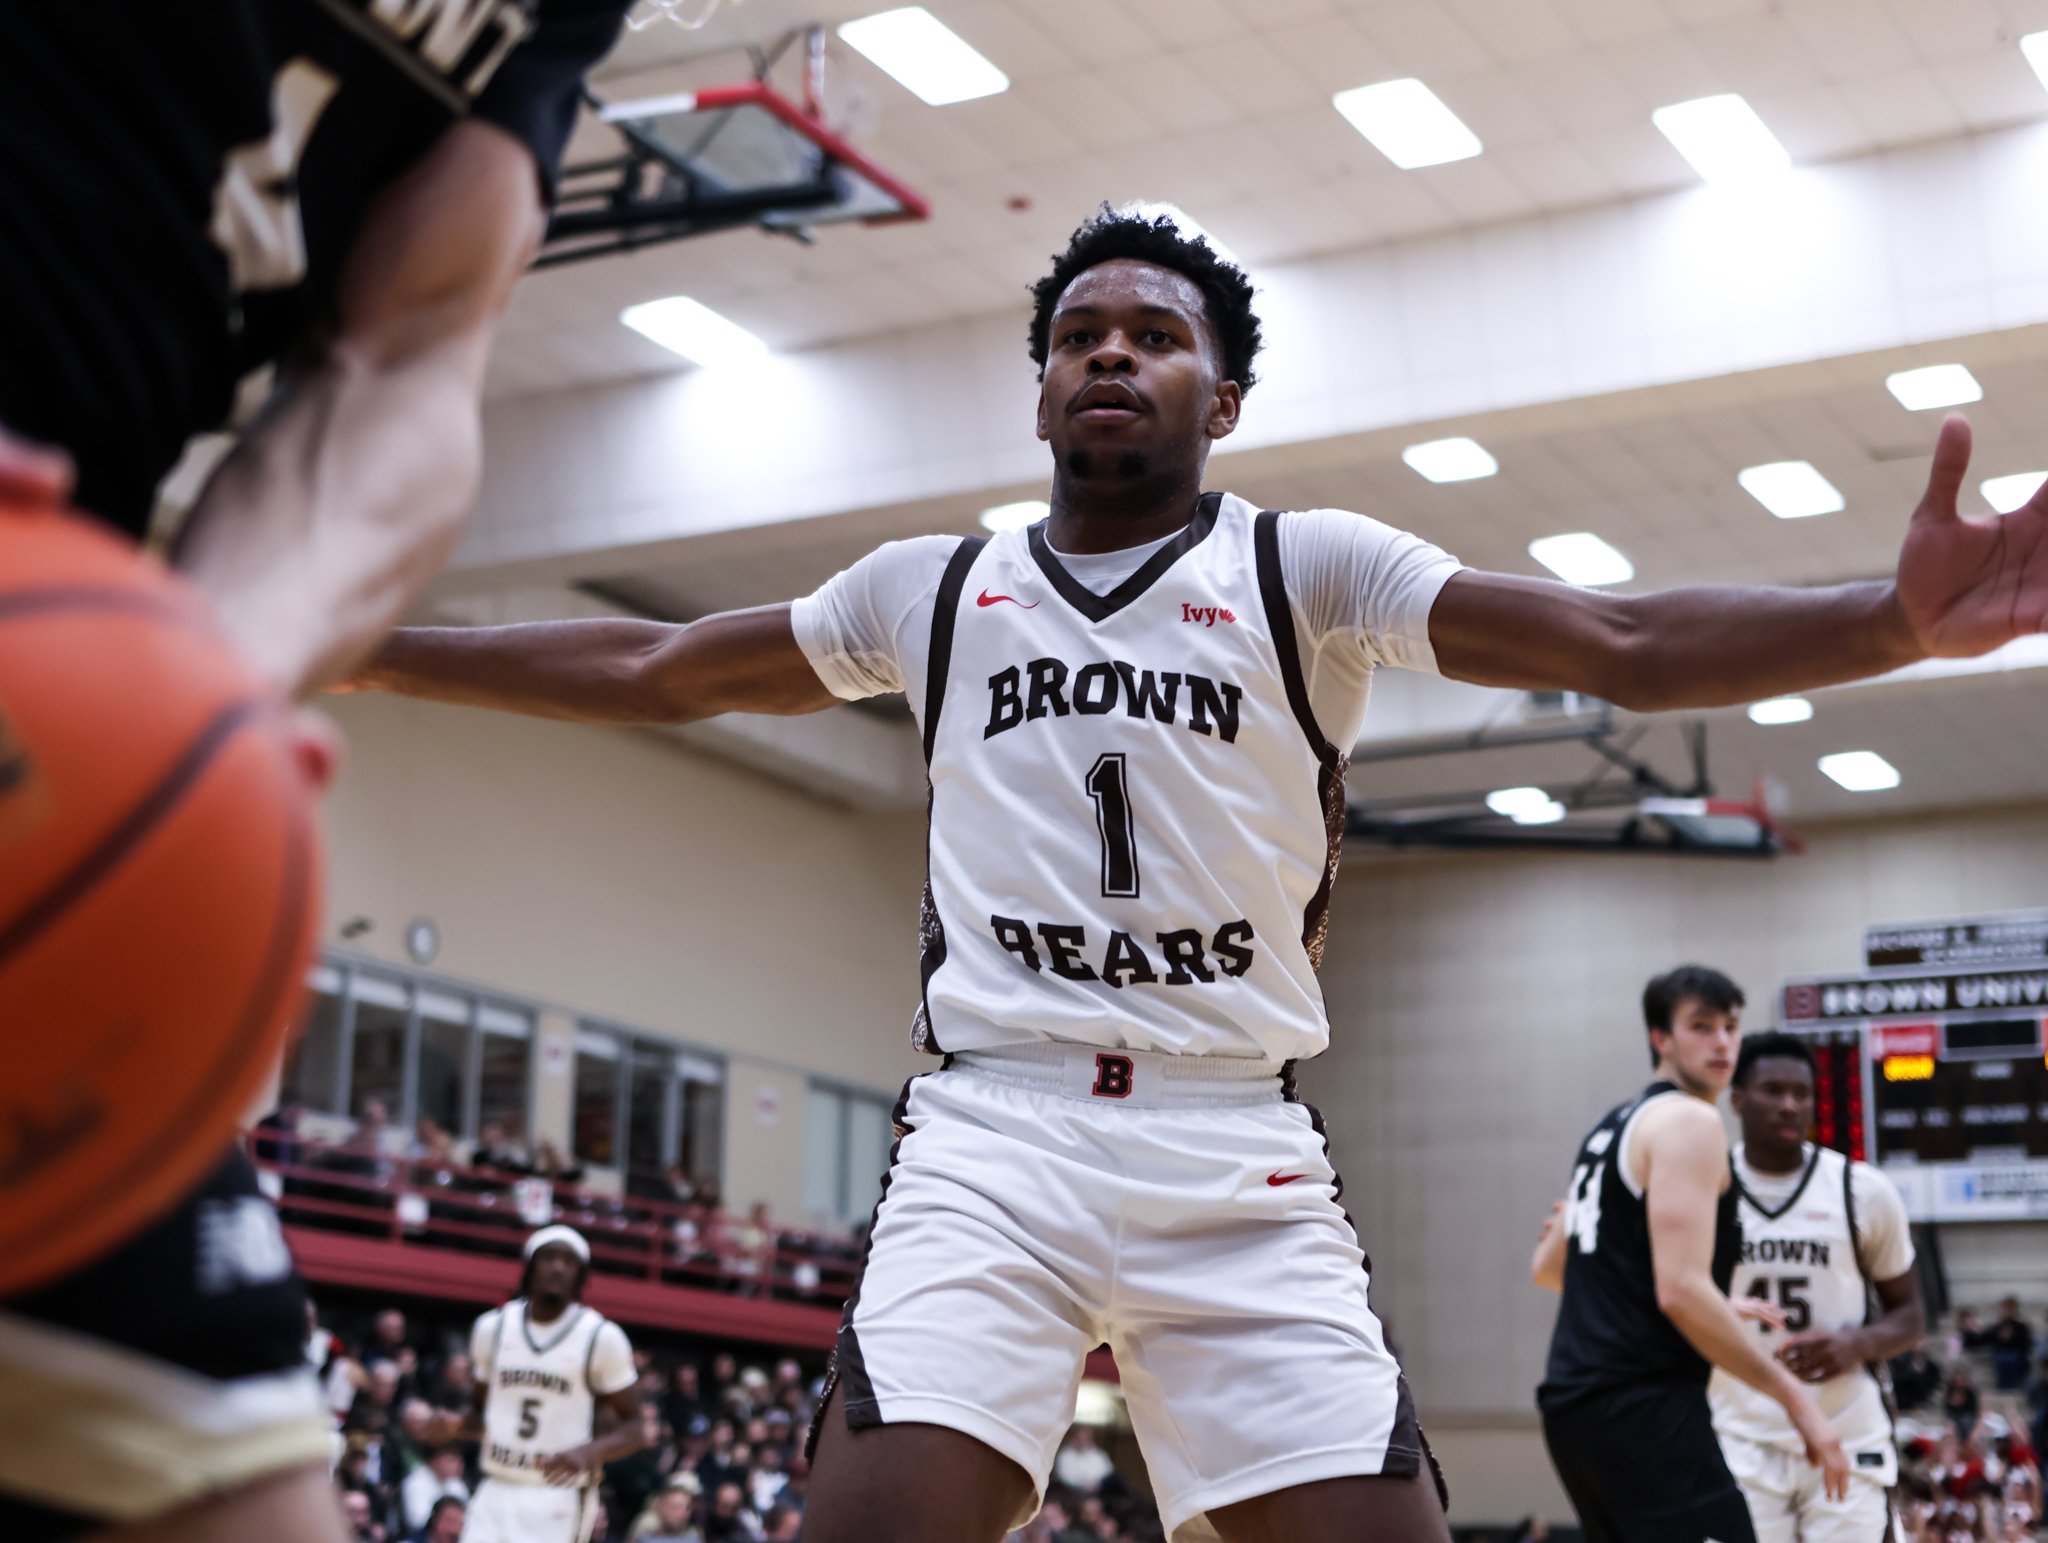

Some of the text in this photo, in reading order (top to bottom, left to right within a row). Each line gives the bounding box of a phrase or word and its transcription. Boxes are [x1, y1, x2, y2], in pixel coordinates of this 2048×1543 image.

[1181, 603, 1217, 627] Ivy
[983, 657, 1243, 744] BROWN
[1085, 752, 1140, 899] 1
[990, 914, 1255, 988] BEARS
[1822, 972, 2048, 1016] BROWN UNIV
[1092, 1053, 1134, 1099] B
[1740, 1238, 1830, 1267] ROWN
[1745, 1275, 1812, 1334] 45
[518, 1398, 541, 1440] 5
